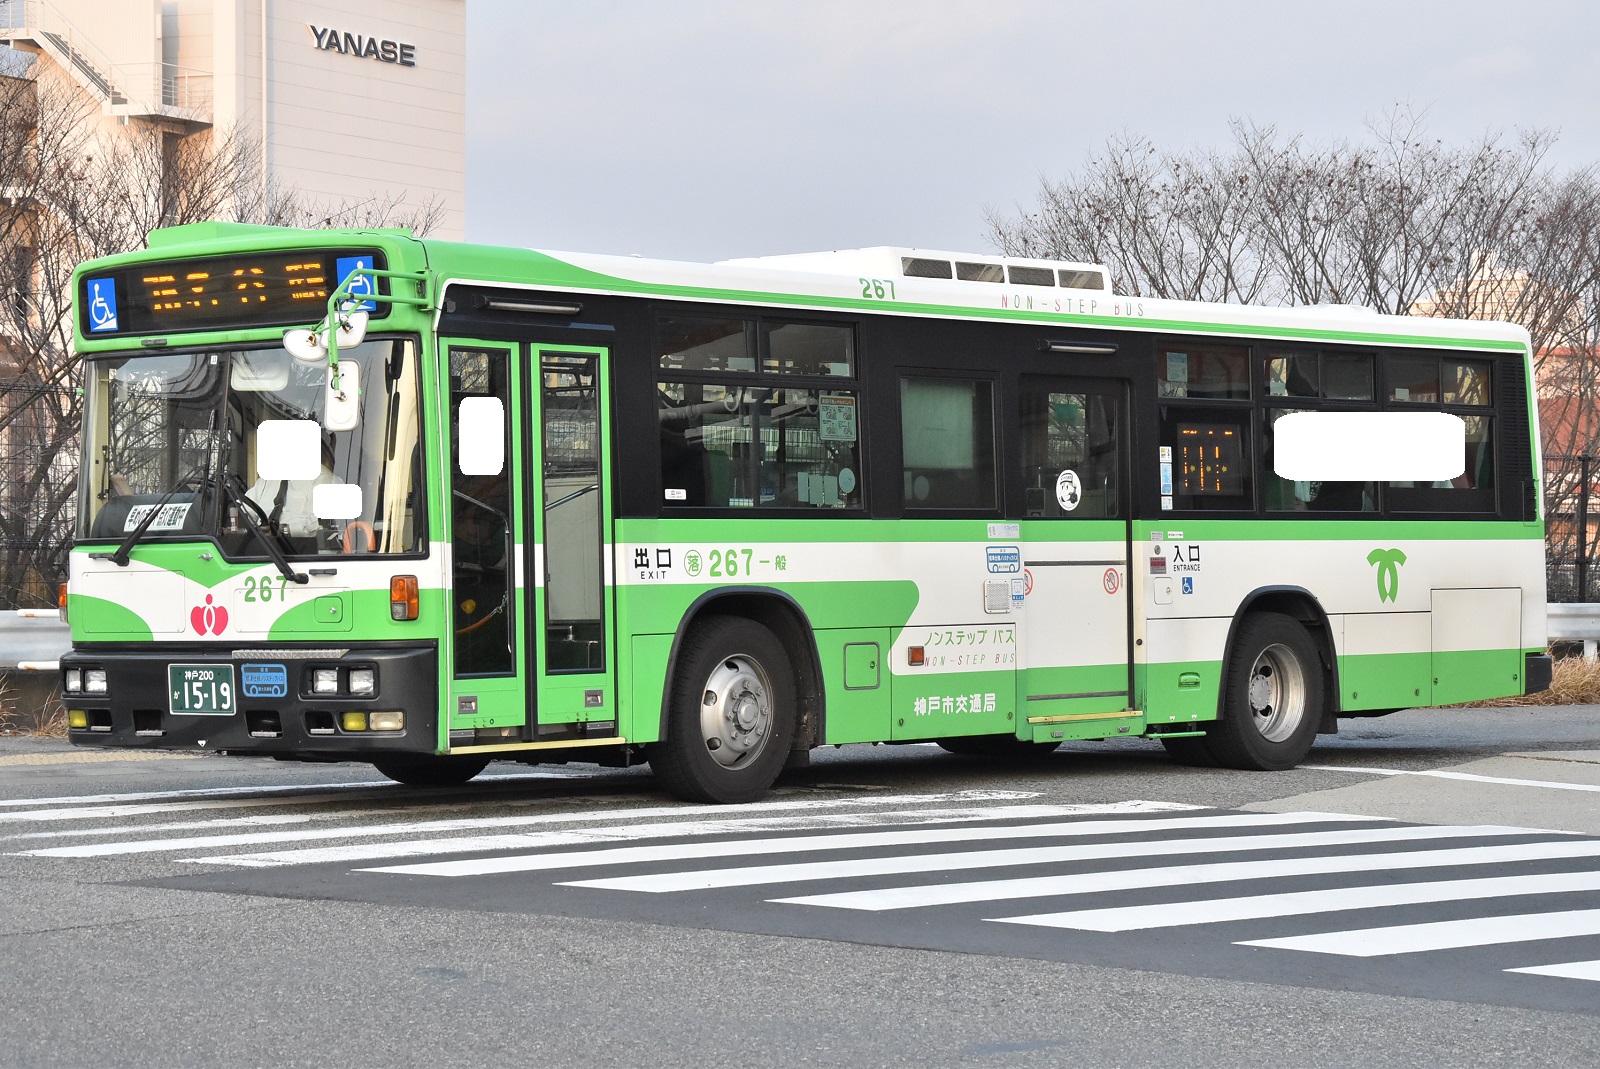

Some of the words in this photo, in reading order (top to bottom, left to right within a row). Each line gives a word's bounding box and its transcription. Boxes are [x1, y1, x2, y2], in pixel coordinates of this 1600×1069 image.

[307, 24, 416, 67] YANASE
[859, 278, 895, 300] 267
[1114, 302, 1144, 316] BUS
[634, 547, 672, 569] 出口
[709, 548, 753, 577] 267
[758, 554, 787, 571] 一般
[1173, 545, 1200, 562] 入口
[640, 571, 667, 580] EXIT
[1173, 564, 1200, 572] ENTRANCE
[244, 576, 288, 602] 267
[924, 629, 988, 647] ノンステップ
[993, 629, 1015, 645] バス
[995, 652, 1015, 664] BUS
[183, 681, 231, 710] 15-19
[913, 692, 996, 717] 神戸市交通局
